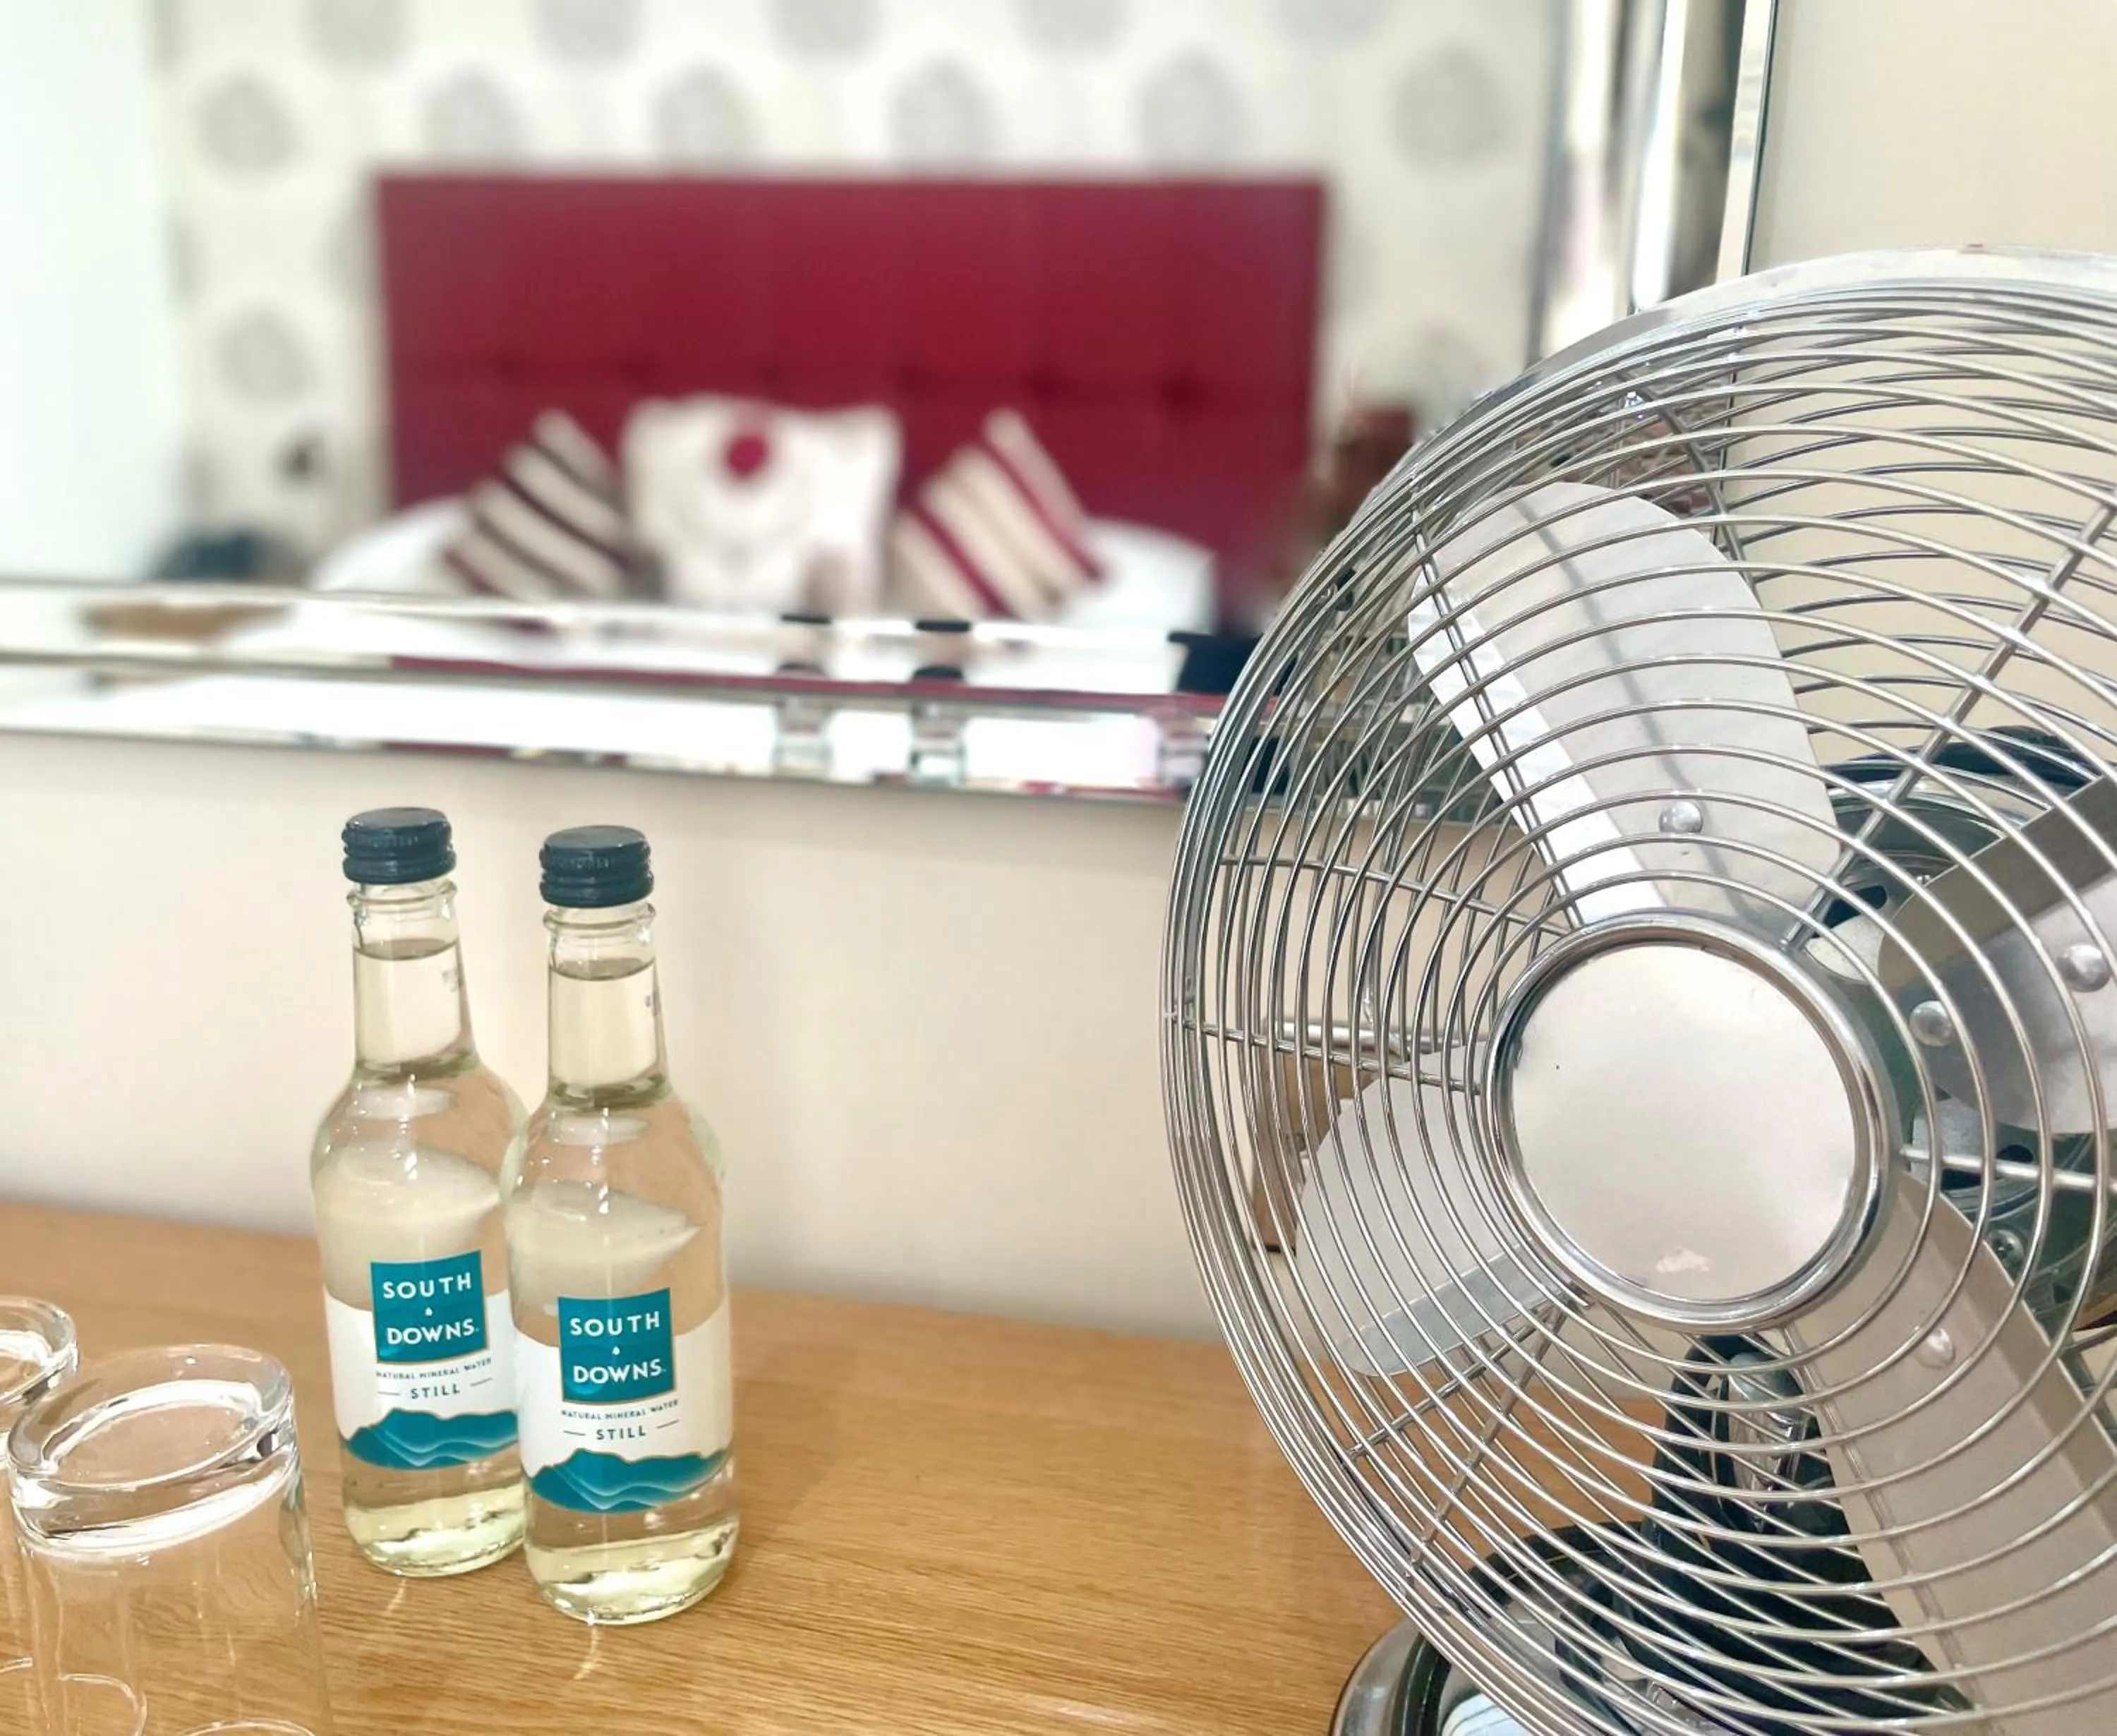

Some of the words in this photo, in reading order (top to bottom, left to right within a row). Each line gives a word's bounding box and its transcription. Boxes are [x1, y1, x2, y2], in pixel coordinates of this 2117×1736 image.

[383, 1272, 471, 1298] SOUTH
[386, 1318, 475, 1344] DOWNS
[570, 1311, 660, 1337] SOUTH
[375, 1371, 415, 1380] NATURAL
[419, 1368, 460, 1378] MINERAL
[464, 1357, 492, 1371] WATER
[573, 1358, 662, 1384] DOWNS
[410, 1383, 460, 1399] STILL
[561, 1410, 601, 1420] NATURAL
[605, 1409, 646, 1419] MINERAL
[651, 1399, 678, 1412] WATER
[596, 1425, 646, 1440] STILL
